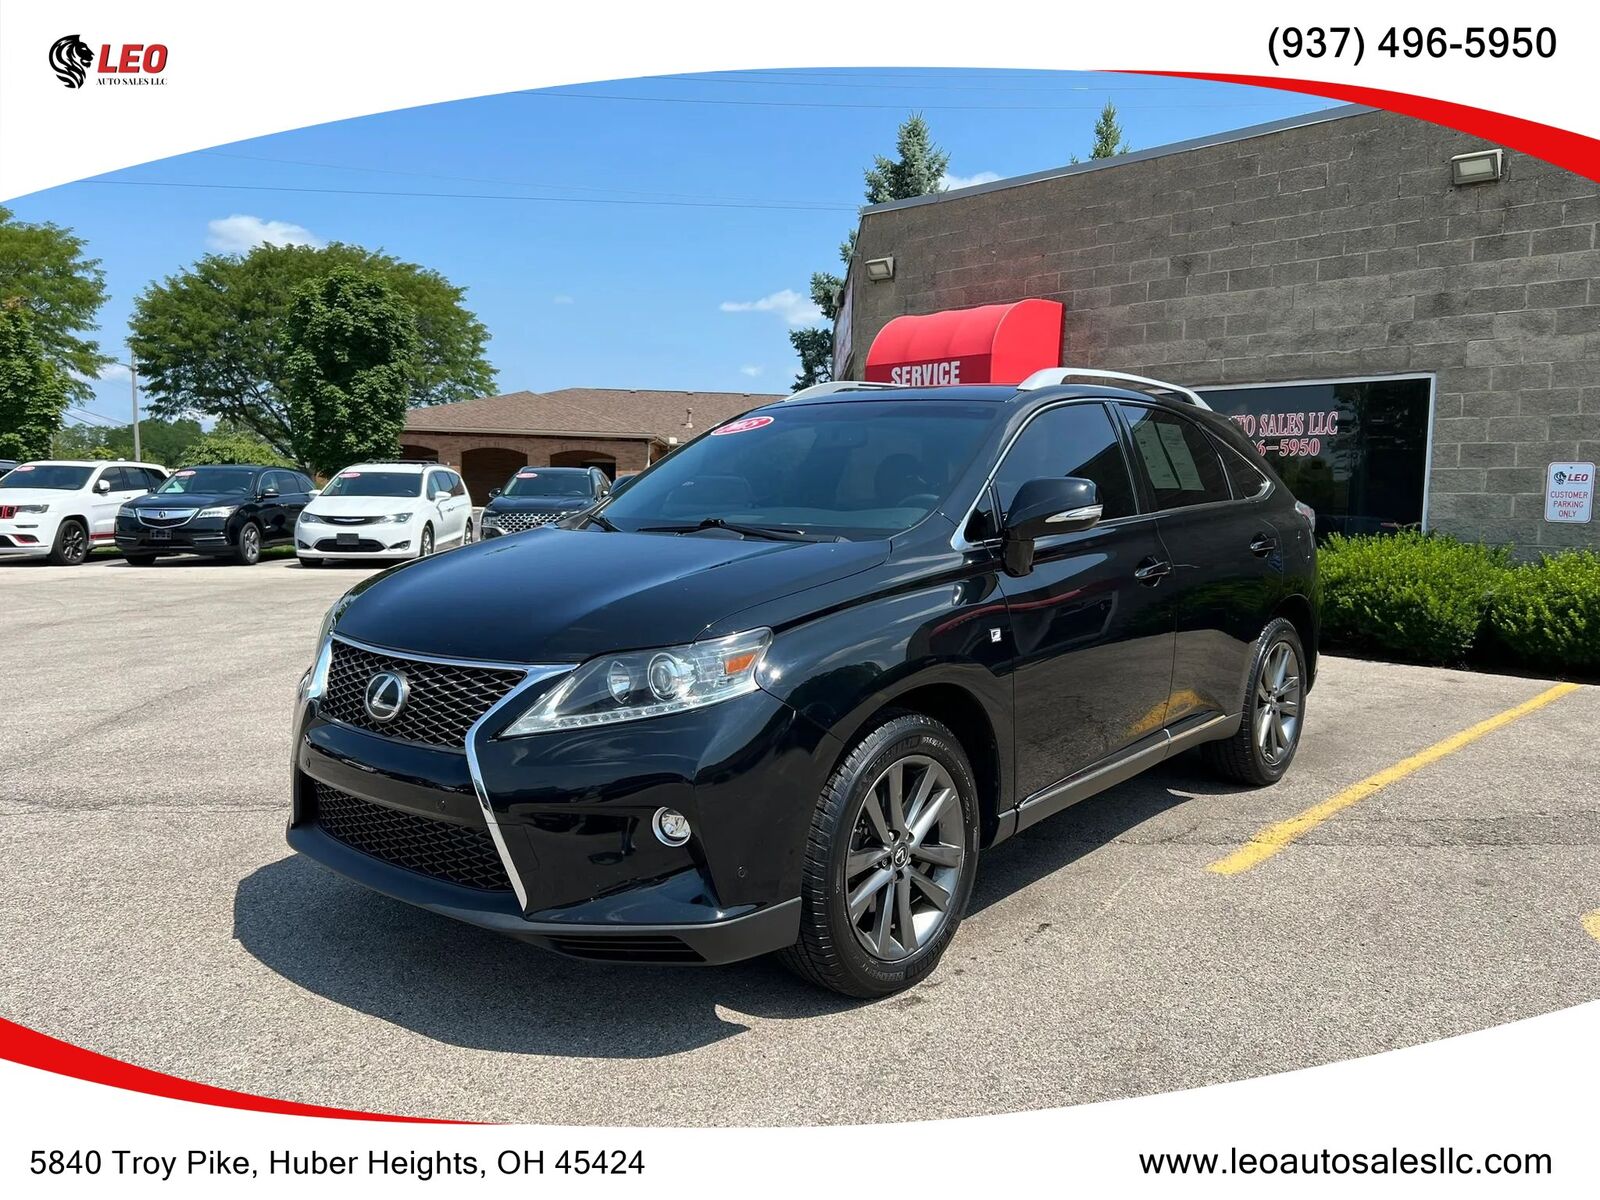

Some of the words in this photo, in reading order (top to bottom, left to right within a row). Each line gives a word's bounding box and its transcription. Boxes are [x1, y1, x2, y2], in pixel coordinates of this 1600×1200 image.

[890, 360, 960, 387] SERVICE
[1231, 414, 1256, 438] TO
[1259, 412, 1304, 437] SALES
[1308, 411, 1339, 435] LLC
[1255, 438, 1320, 457] 6-5950
[1567, 473, 1589, 482] LEO
[1550, 490, 1589, 499] CUSTOMER
[1553, 500, 1584, 508] PARKING
[1558, 510, 1577, 518] ONLY
